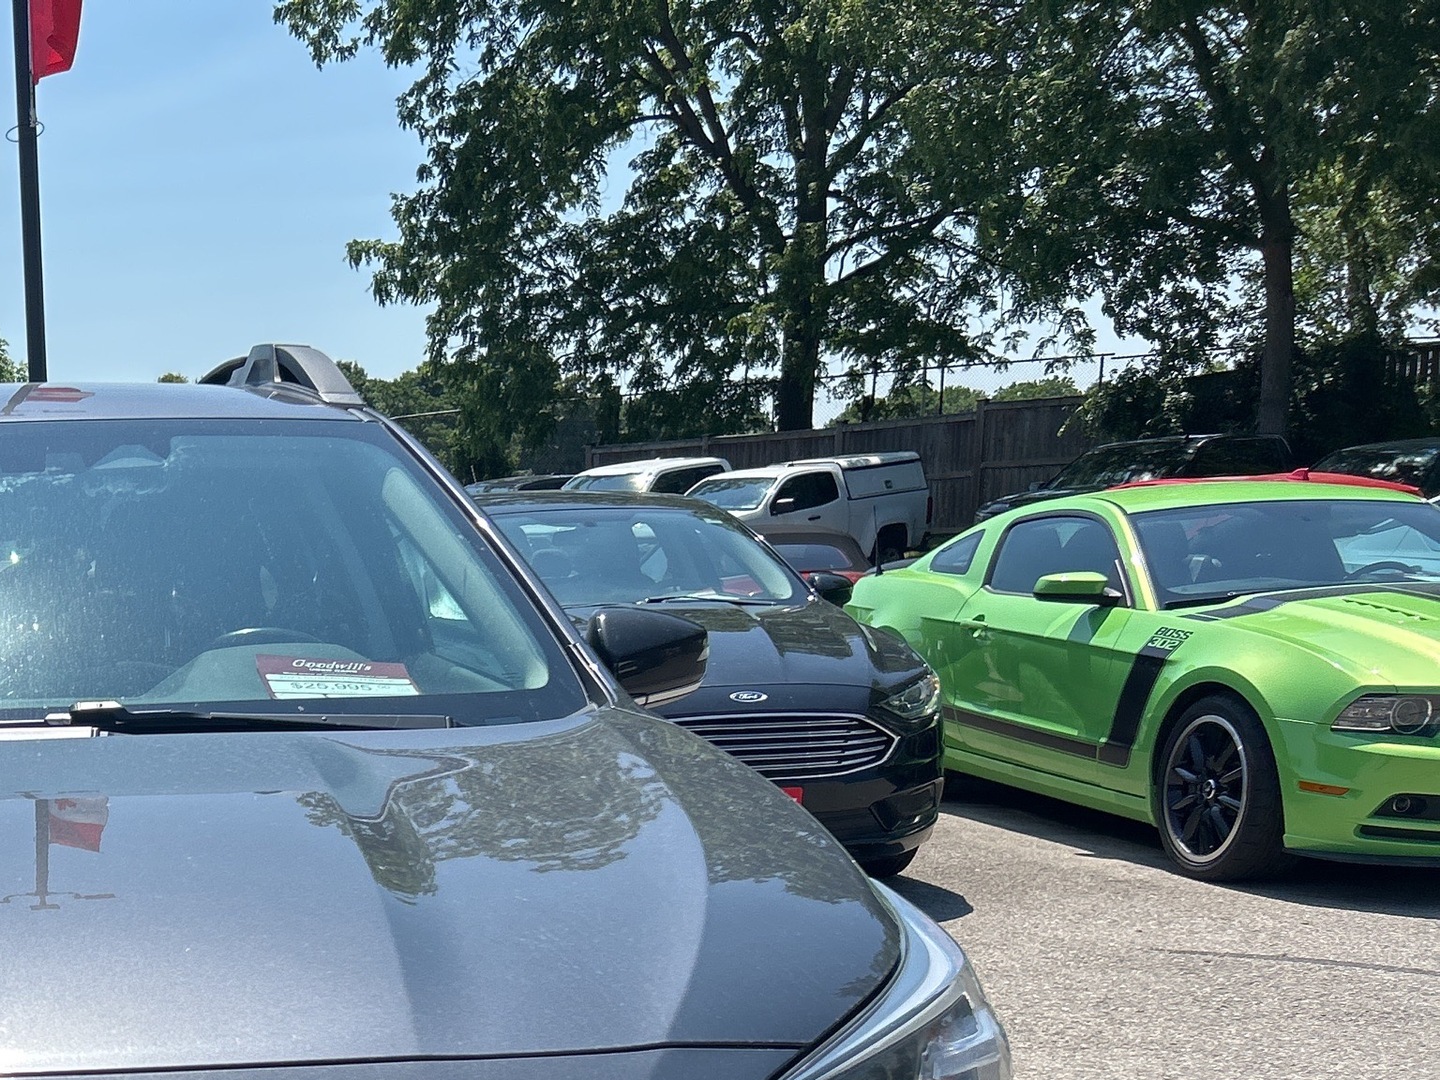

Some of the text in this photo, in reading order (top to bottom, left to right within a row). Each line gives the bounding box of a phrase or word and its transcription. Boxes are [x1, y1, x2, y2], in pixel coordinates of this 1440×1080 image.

[1154, 626, 1194, 640] BOSS
[1147, 637, 1180, 651] 302
[292, 659, 372, 671] Goodwill's
